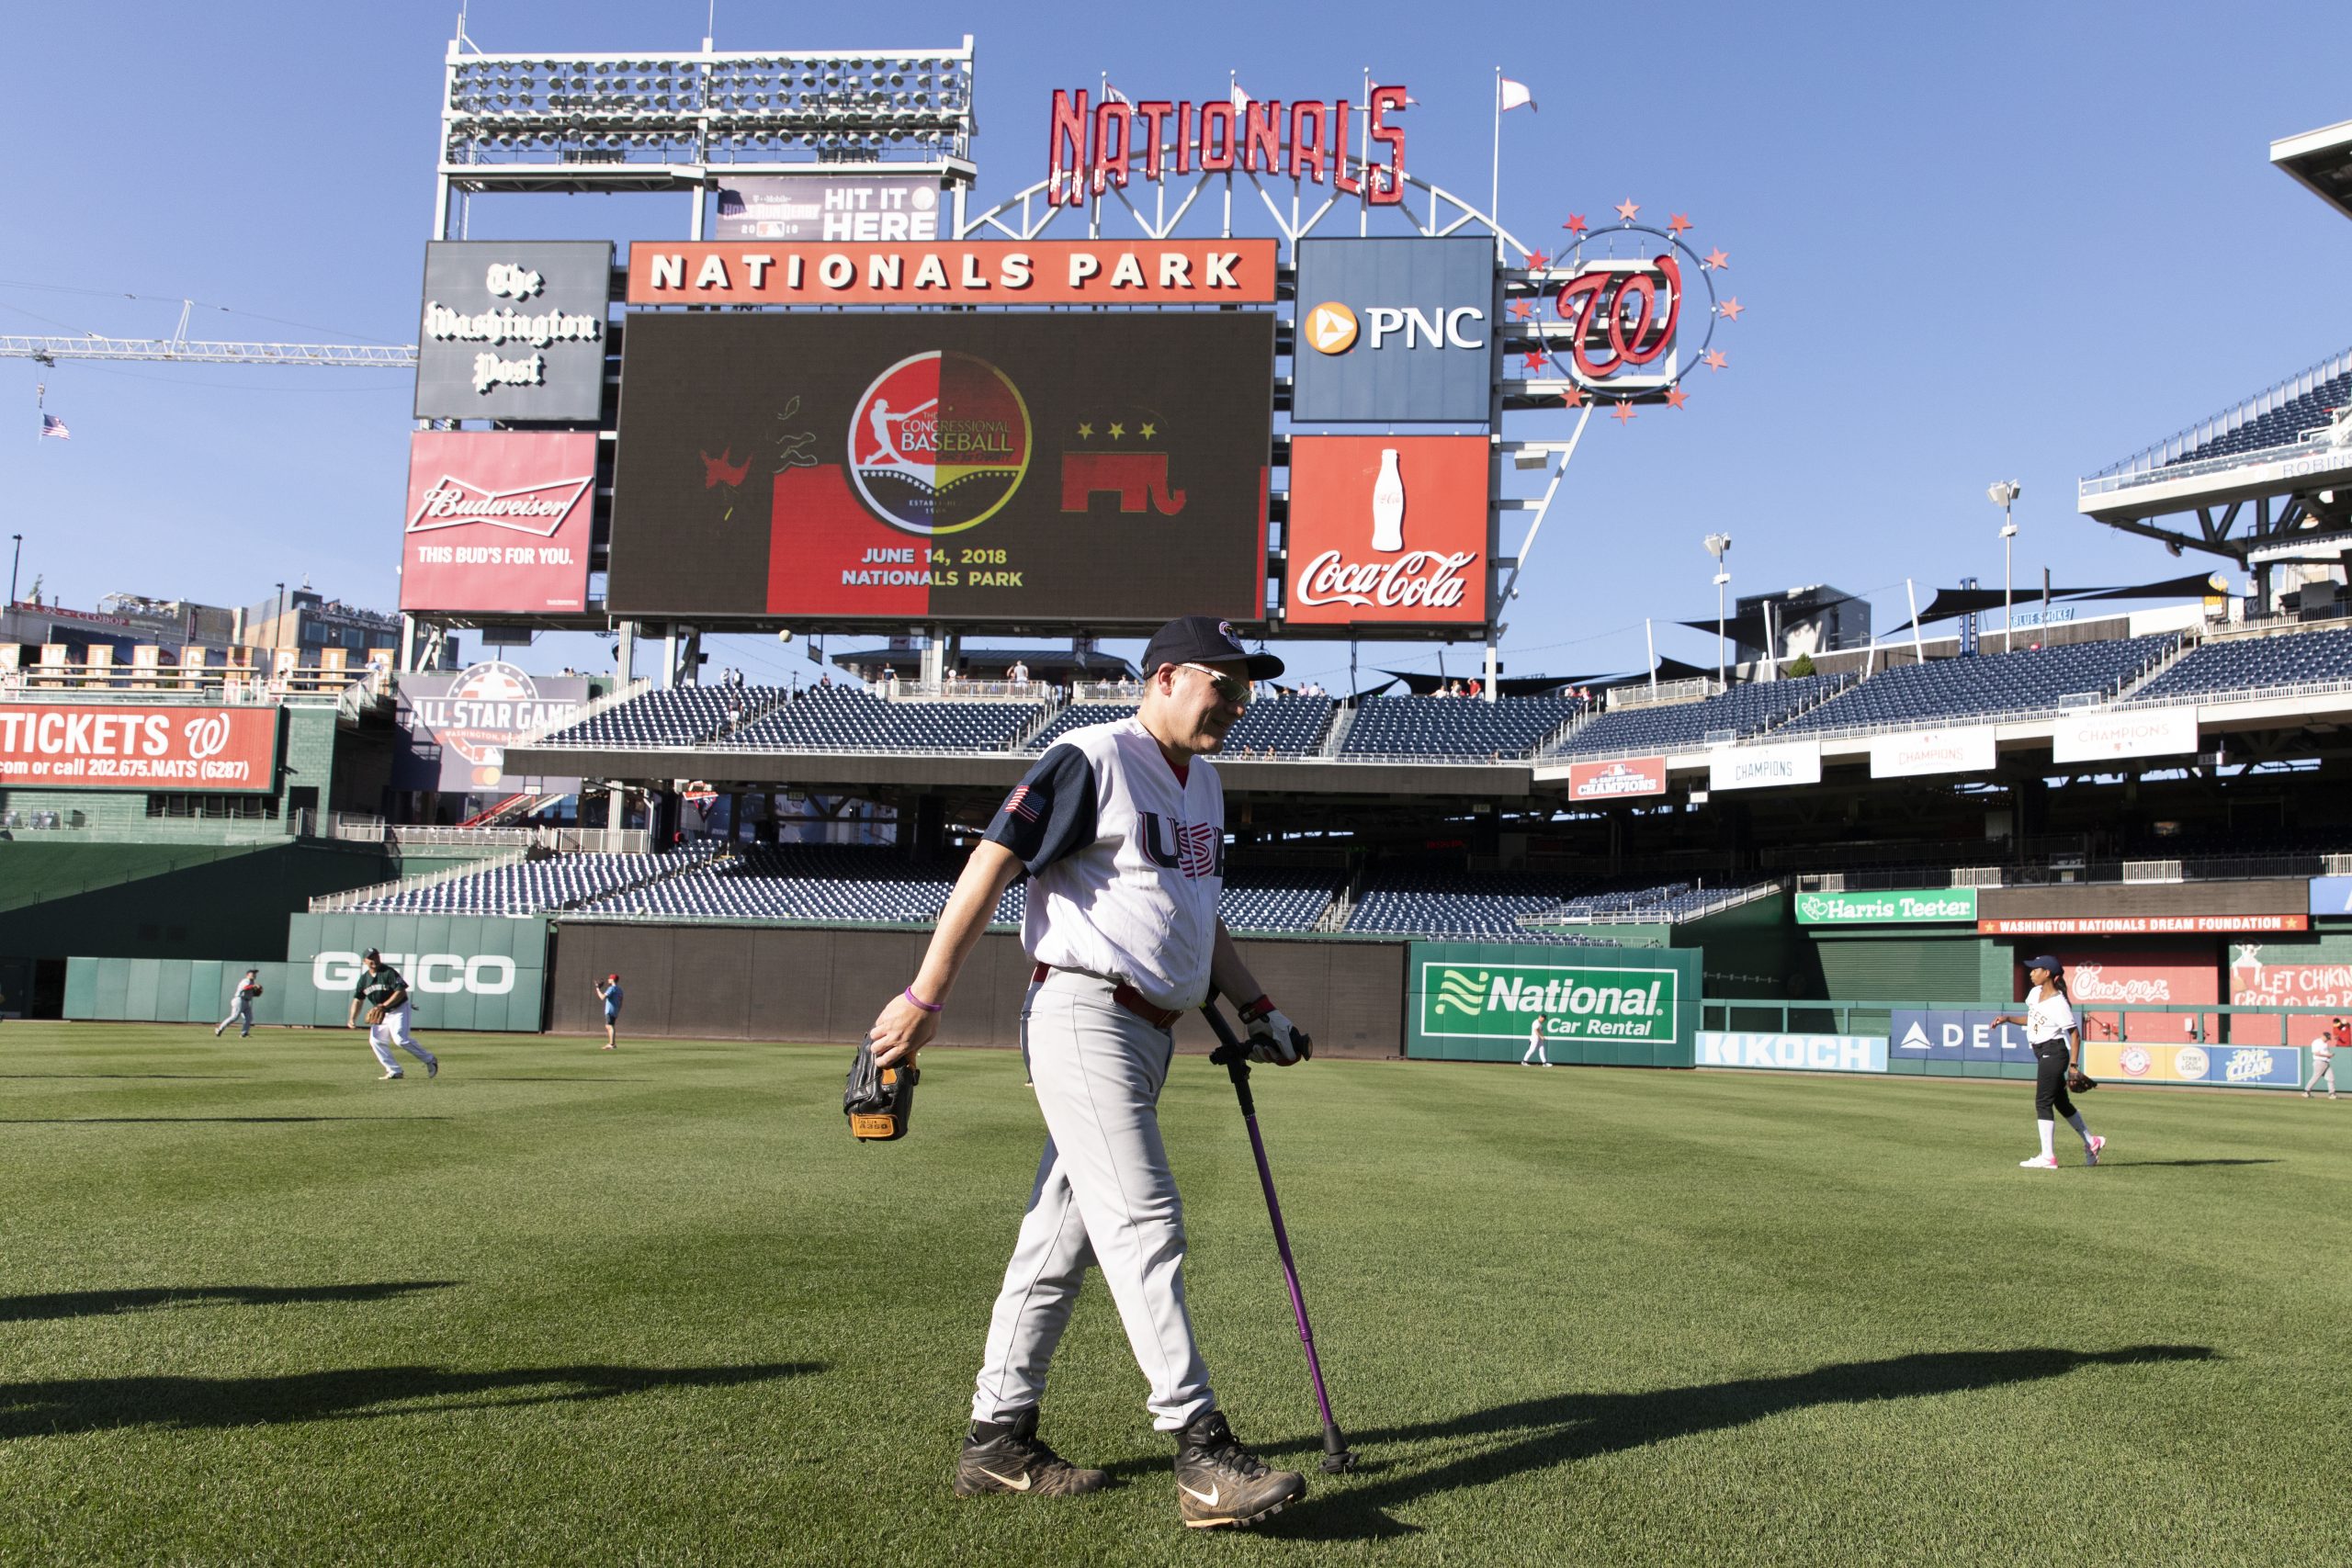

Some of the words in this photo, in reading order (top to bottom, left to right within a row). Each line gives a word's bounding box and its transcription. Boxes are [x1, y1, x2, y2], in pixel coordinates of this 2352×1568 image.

[1047, 85, 1407, 208] NATIONALS
[824, 187, 873, 210] HIT
[879, 187, 908, 210] IT
[822, 211, 936, 242] HERE
[486, 263, 542, 299] The
[650, 253, 1035, 289] NATIONALS
[1069, 252, 1242, 288] PARK
[424, 300, 598, 346] Washington
[1364, 306, 1485, 349] PNC
[472, 352, 543, 393] Post
[901, 419, 1011, 434] CONGRESSIONAL
[901, 433, 1014, 451] BASEBALL
[423, 488, 571, 518] Budweiser
[417, 547, 453, 564] THIS
[455, 547, 502, 564] BUD'S
[504, 547, 536, 565] FOR
[538, 547, 574, 565] YOU.
[861, 547, 914, 563] JUNE
[923, 548, 951, 566] 14,
[960, 549, 1007, 564] 2018
[842, 570, 959, 586] NATIONALS
[968, 571, 1023, 587] PARK
[1296, 549, 1476, 607] Coca-Cola
[2013, 614, 2036, 626] BLUE
[453, 700, 511, 729] STAR
[0, 712, 171, 757] TICKETS
[2077, 723, 2171, 743] CHAMPIONS
[1898, 746, 1964, 766] CHAMPIONS
[32, 761, 51, 774] or
[53, 758, 85, 776] call
[87, 758, 198, 778] 202.675.NATS
[200, 760, 250, 781] (6287)
[1735, 760, 1793, 781] CHAMPIONS
[1577, 779, 1657, 795] CHAMPIONS
[1826, 899, 1894, 919] Harris
[1899, 897, 1971, 918] Teeter
[1999, 920, 2075, 933] WASHINGTON
[2078, 919, 2146, 931] NATIONALS
[2149, 919, 2194, 931] DREAM
[2198, 917, 2281, 930] FOUNDATION
[2261, 970, 2296, 994] LET
[1487, 976, 1662, 1016] National
[1546, 1018, 1580, 1034] Car
[1586, 1019, 1653, 1036] Rental
[1745, 1033, 1871, 1069] KOCH
